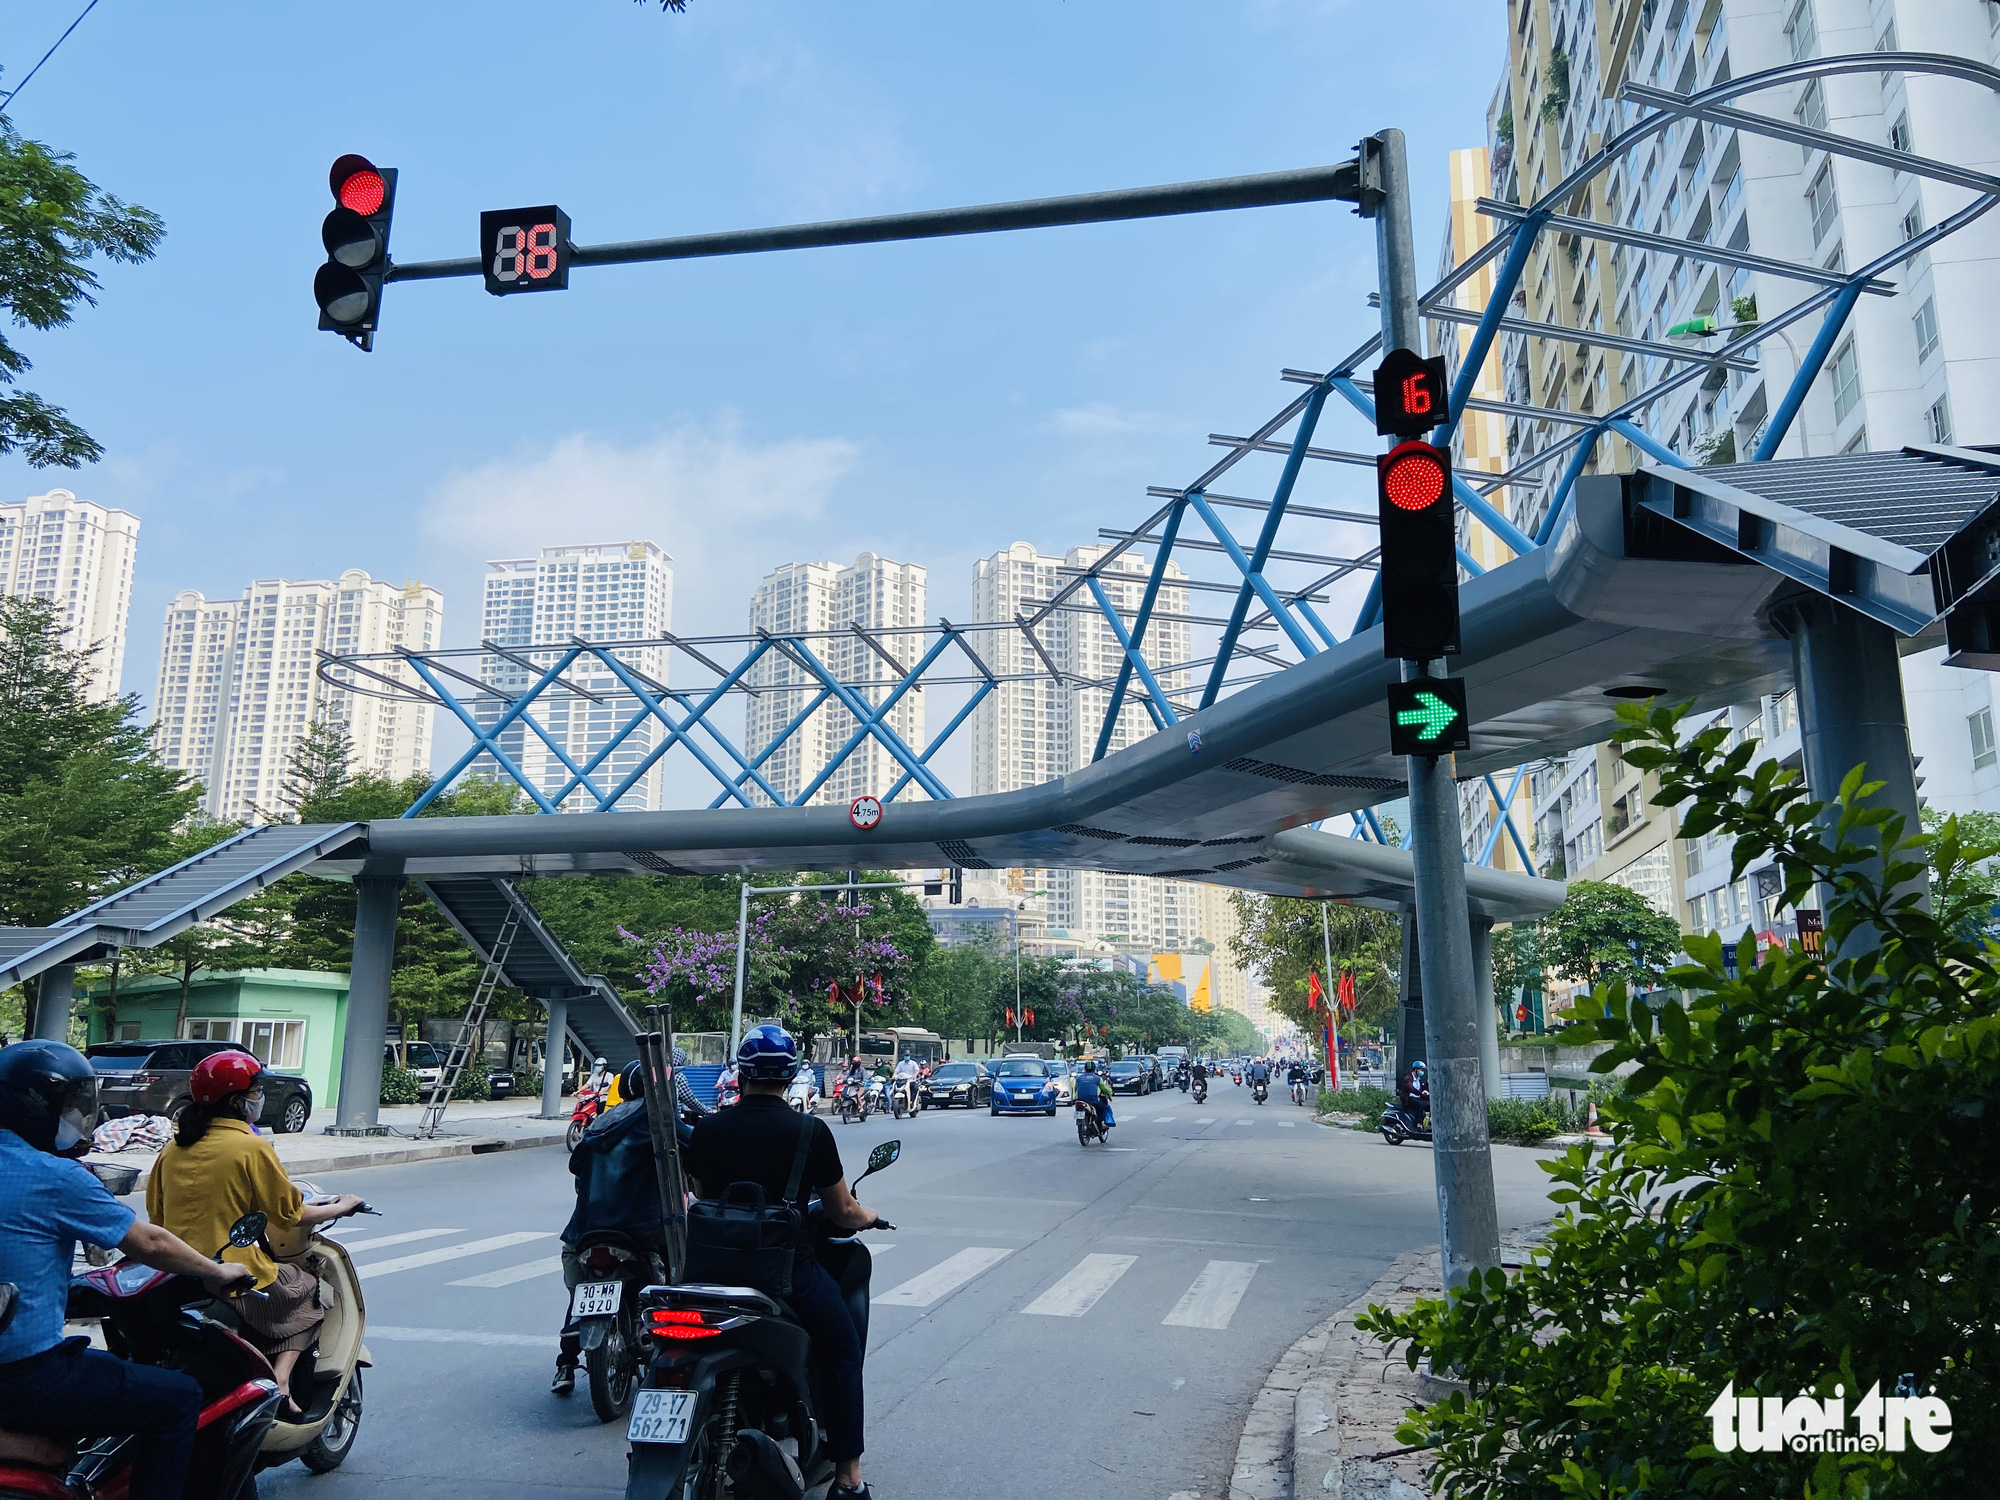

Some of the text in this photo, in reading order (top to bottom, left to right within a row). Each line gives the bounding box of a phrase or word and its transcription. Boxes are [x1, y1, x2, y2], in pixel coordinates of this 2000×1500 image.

[1403, 374, 1430, 414] 16
[853, 804, 879, 817] 4,75m
[579, 1300, 612, 1313] 9920
[641, 1393, 689, 1415] 29-Y7
[630, 1416, 687, 1440] 562.71
